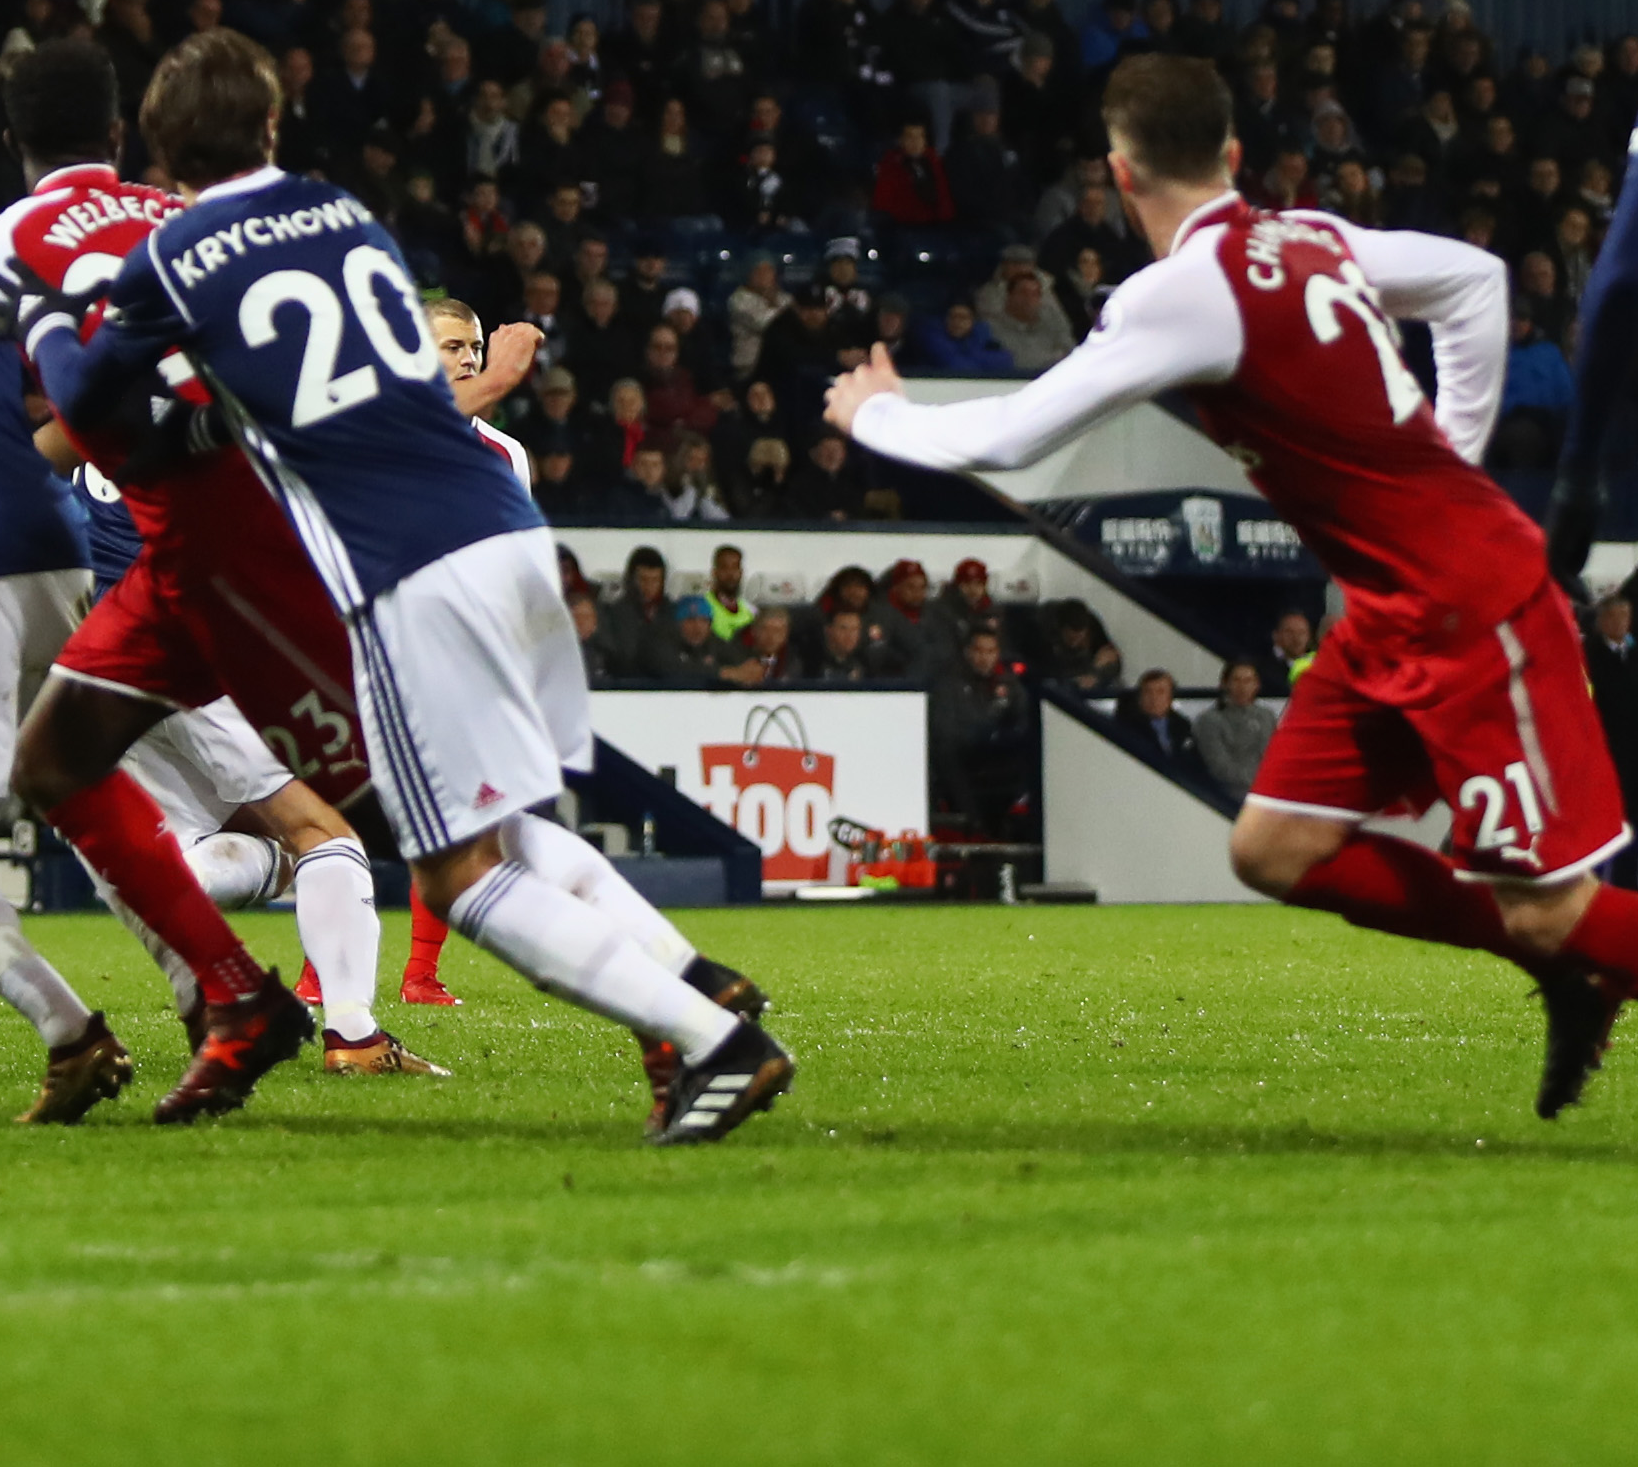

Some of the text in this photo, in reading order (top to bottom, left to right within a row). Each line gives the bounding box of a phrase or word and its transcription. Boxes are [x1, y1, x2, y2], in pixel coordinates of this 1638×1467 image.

[238, 244, 439, 428] 20
[262, 689, 351, 779] 23
[1459, 760, 1544, 851] 21
